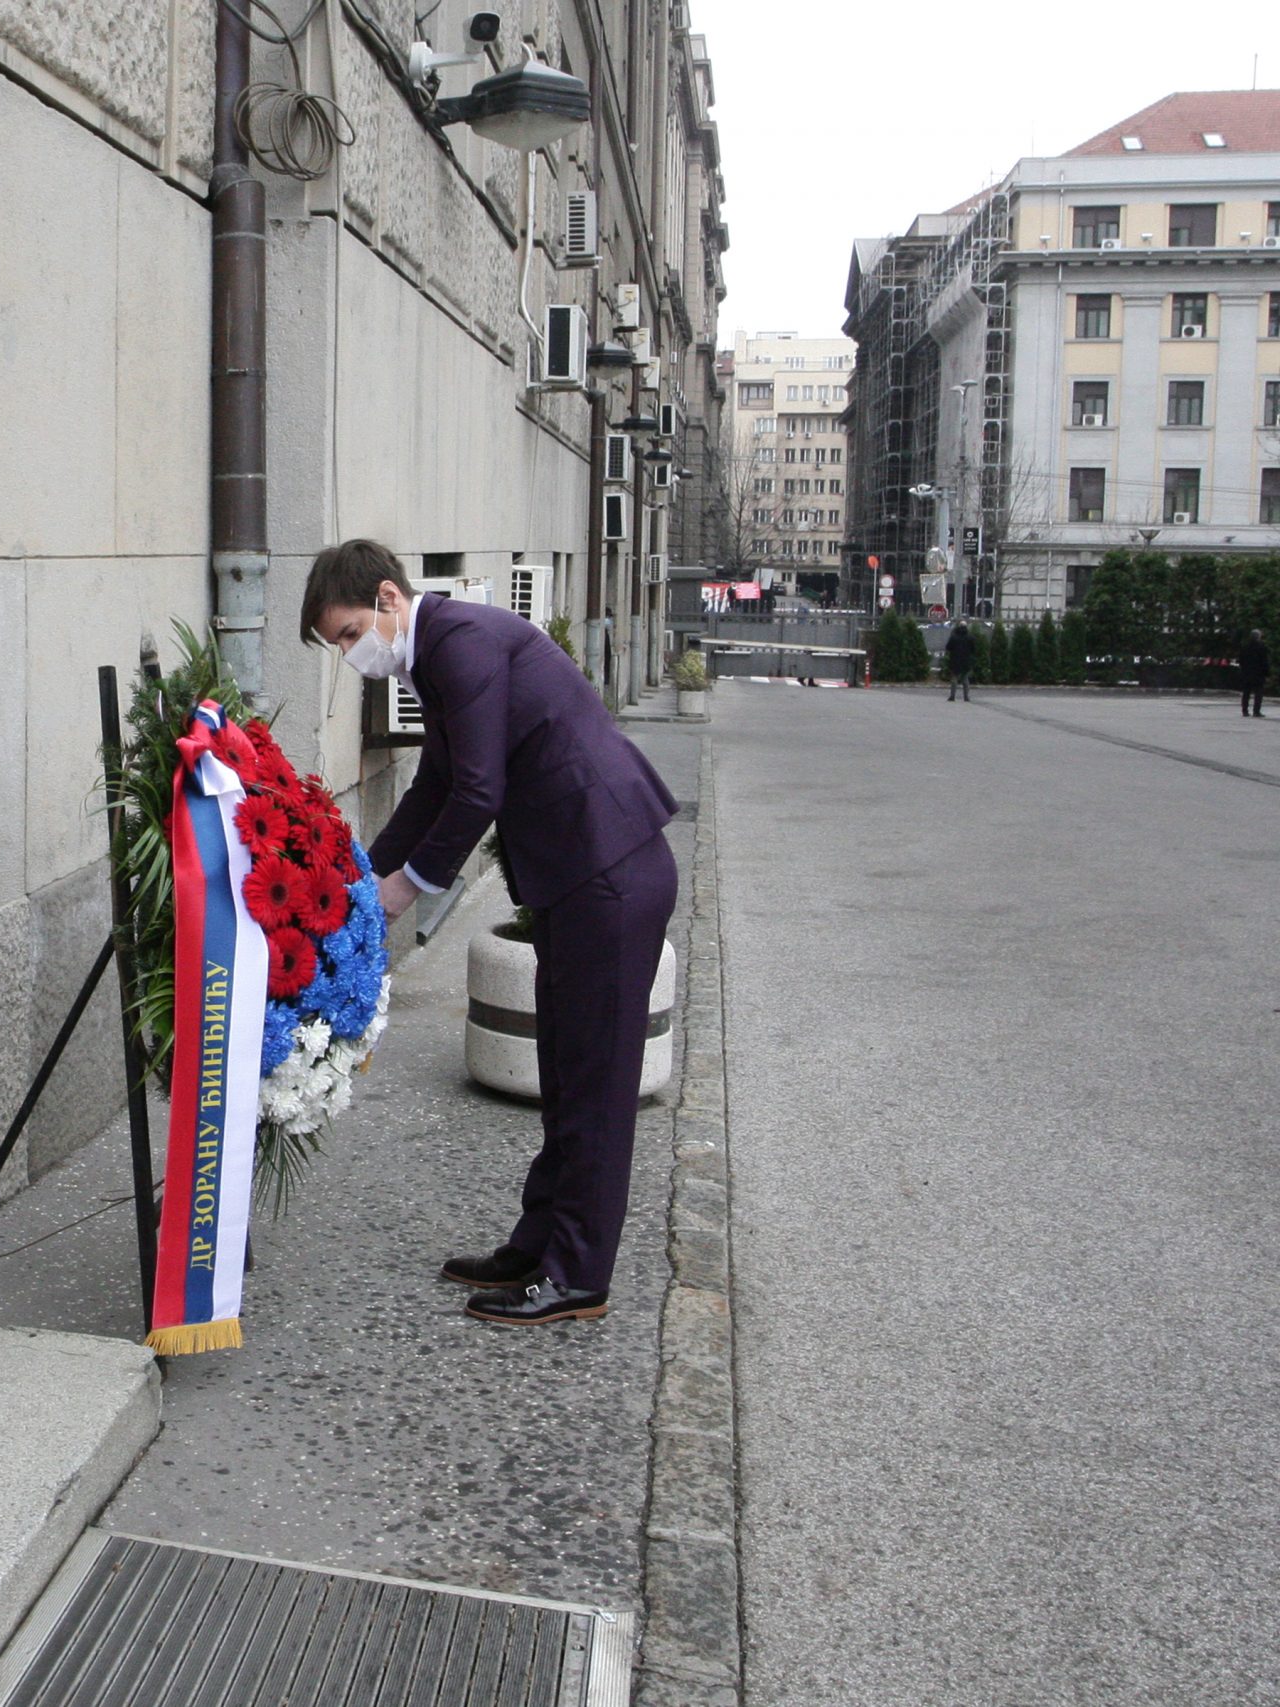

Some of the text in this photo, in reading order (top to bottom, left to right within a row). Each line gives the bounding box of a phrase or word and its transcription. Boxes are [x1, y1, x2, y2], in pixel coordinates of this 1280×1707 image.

[191, 960, 229, 1271] ДР ЗОРАНУ ЂИНЂИЋУ
